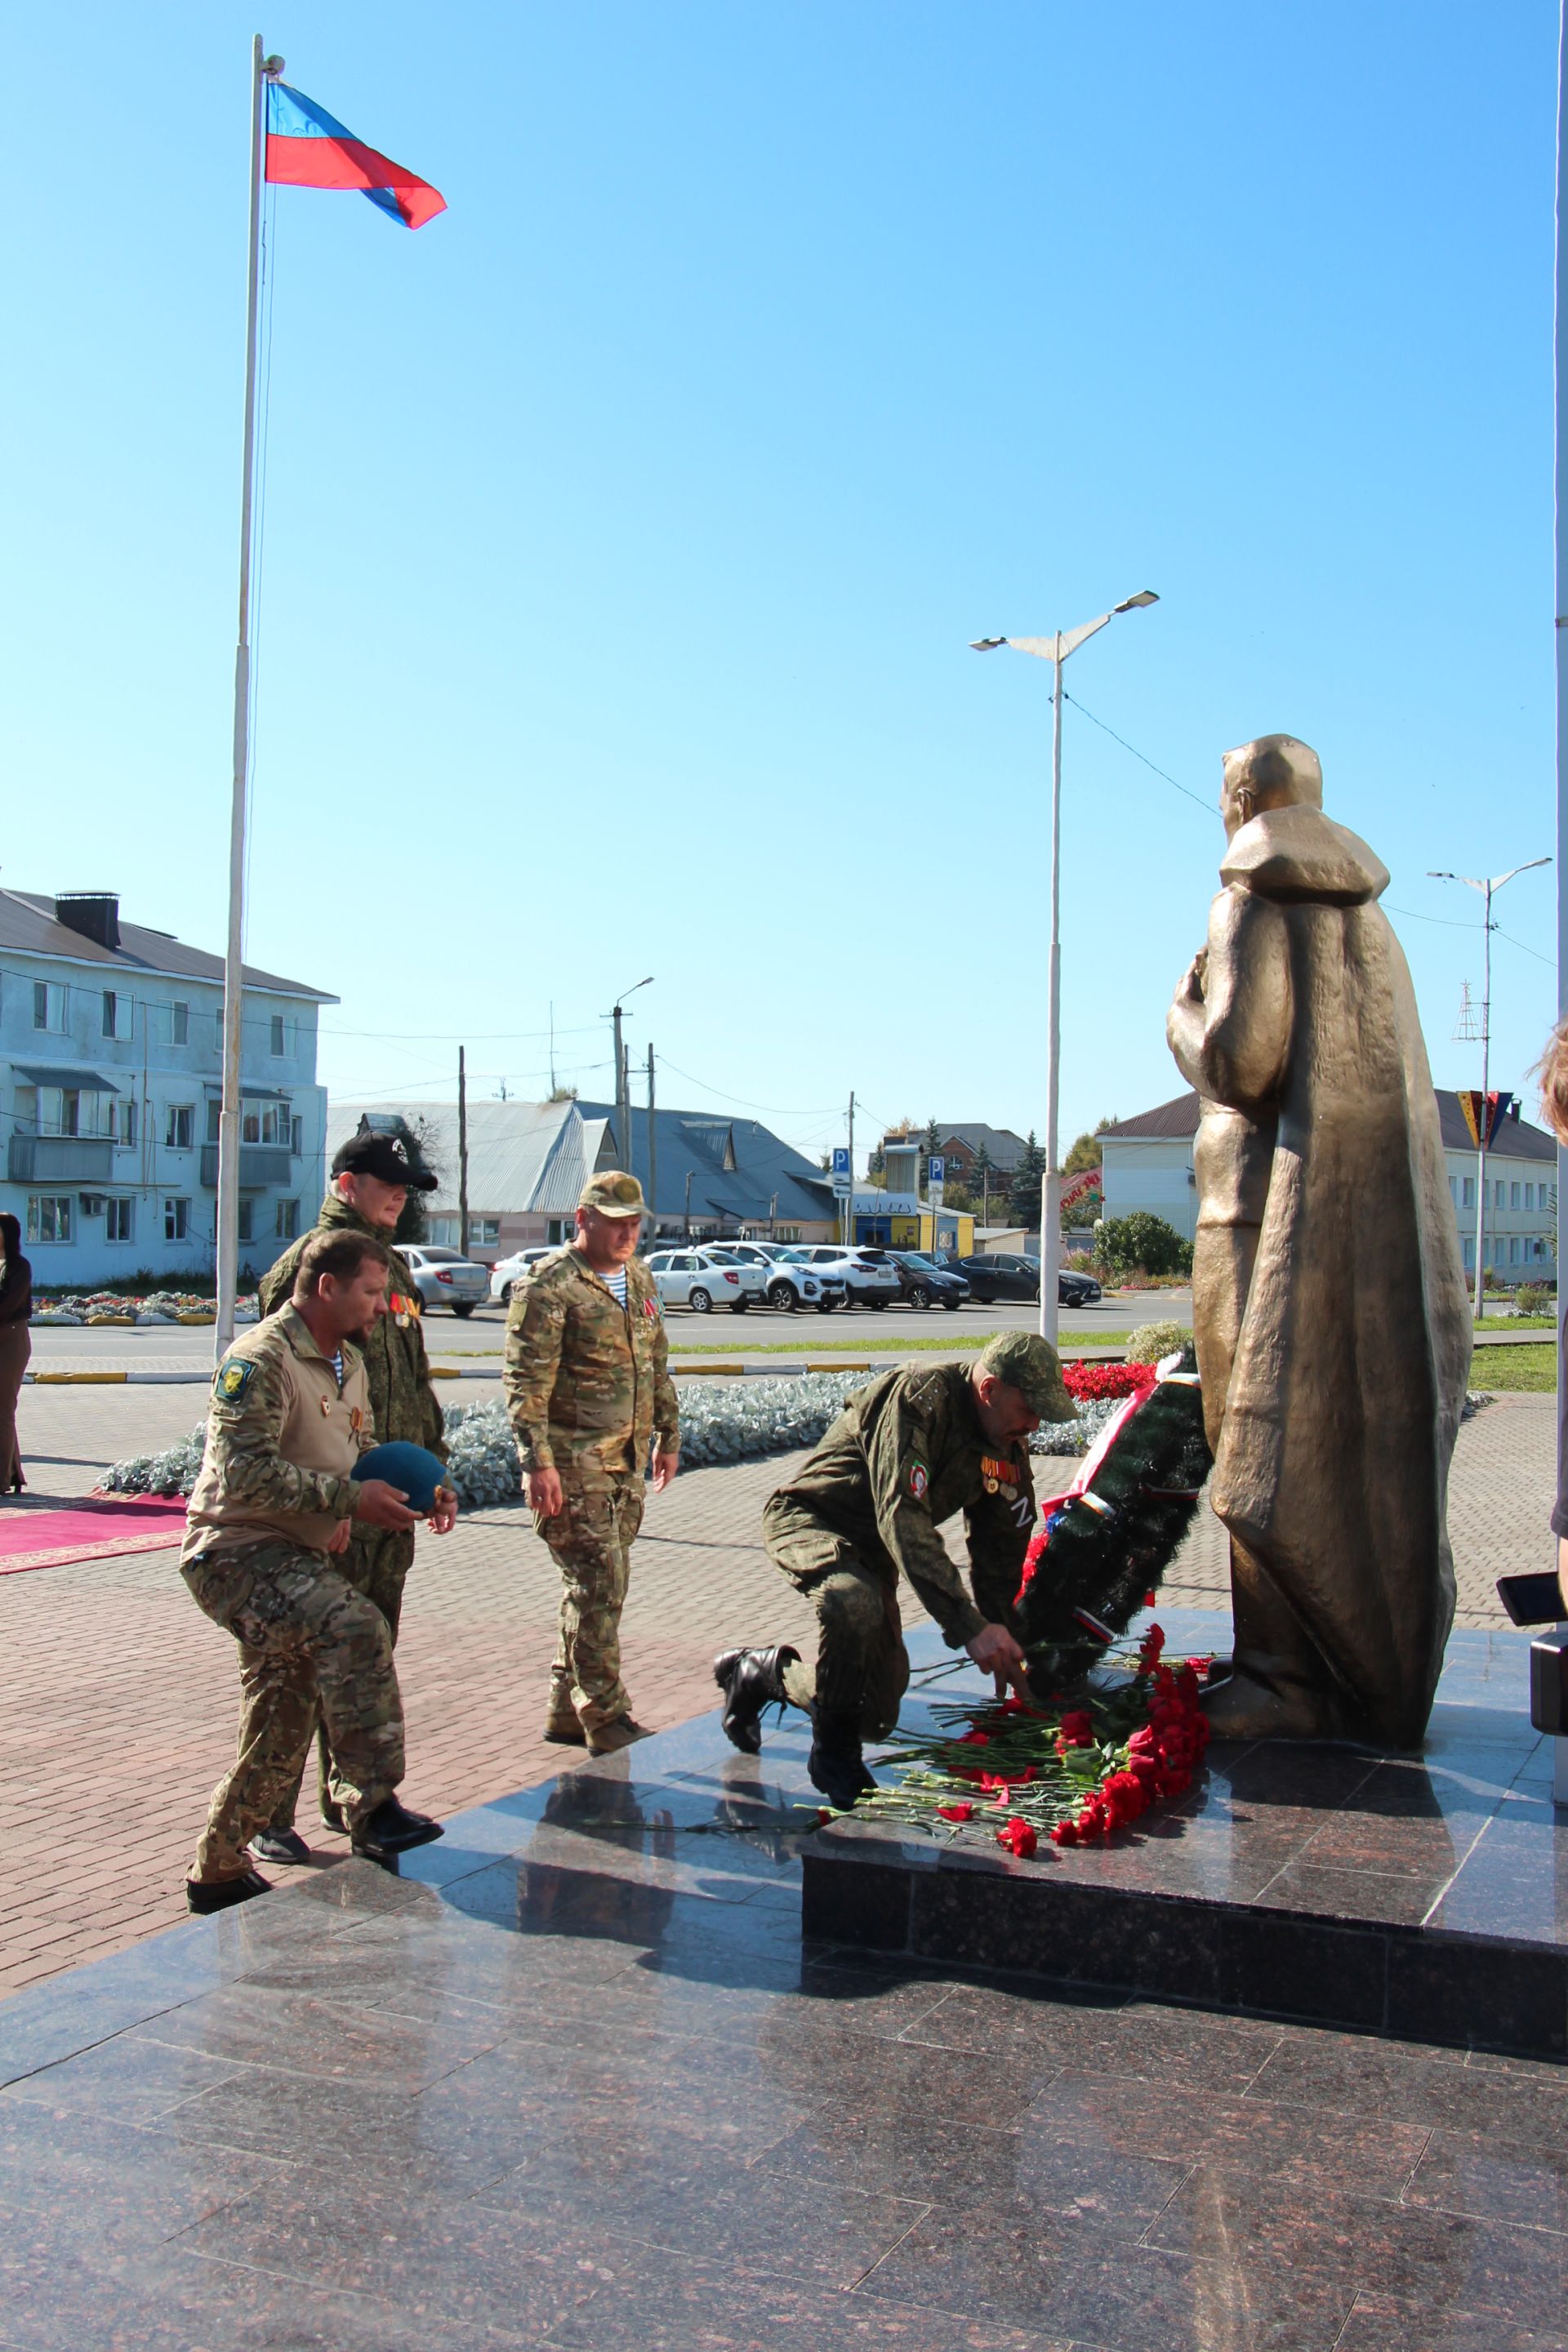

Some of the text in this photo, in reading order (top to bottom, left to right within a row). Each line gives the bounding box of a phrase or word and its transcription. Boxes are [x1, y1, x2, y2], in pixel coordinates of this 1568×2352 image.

[836, 1150, 845, 1169] P
[932, 1160, 941, 1178] P
[1010, 1496, 1033, 1527] Z
